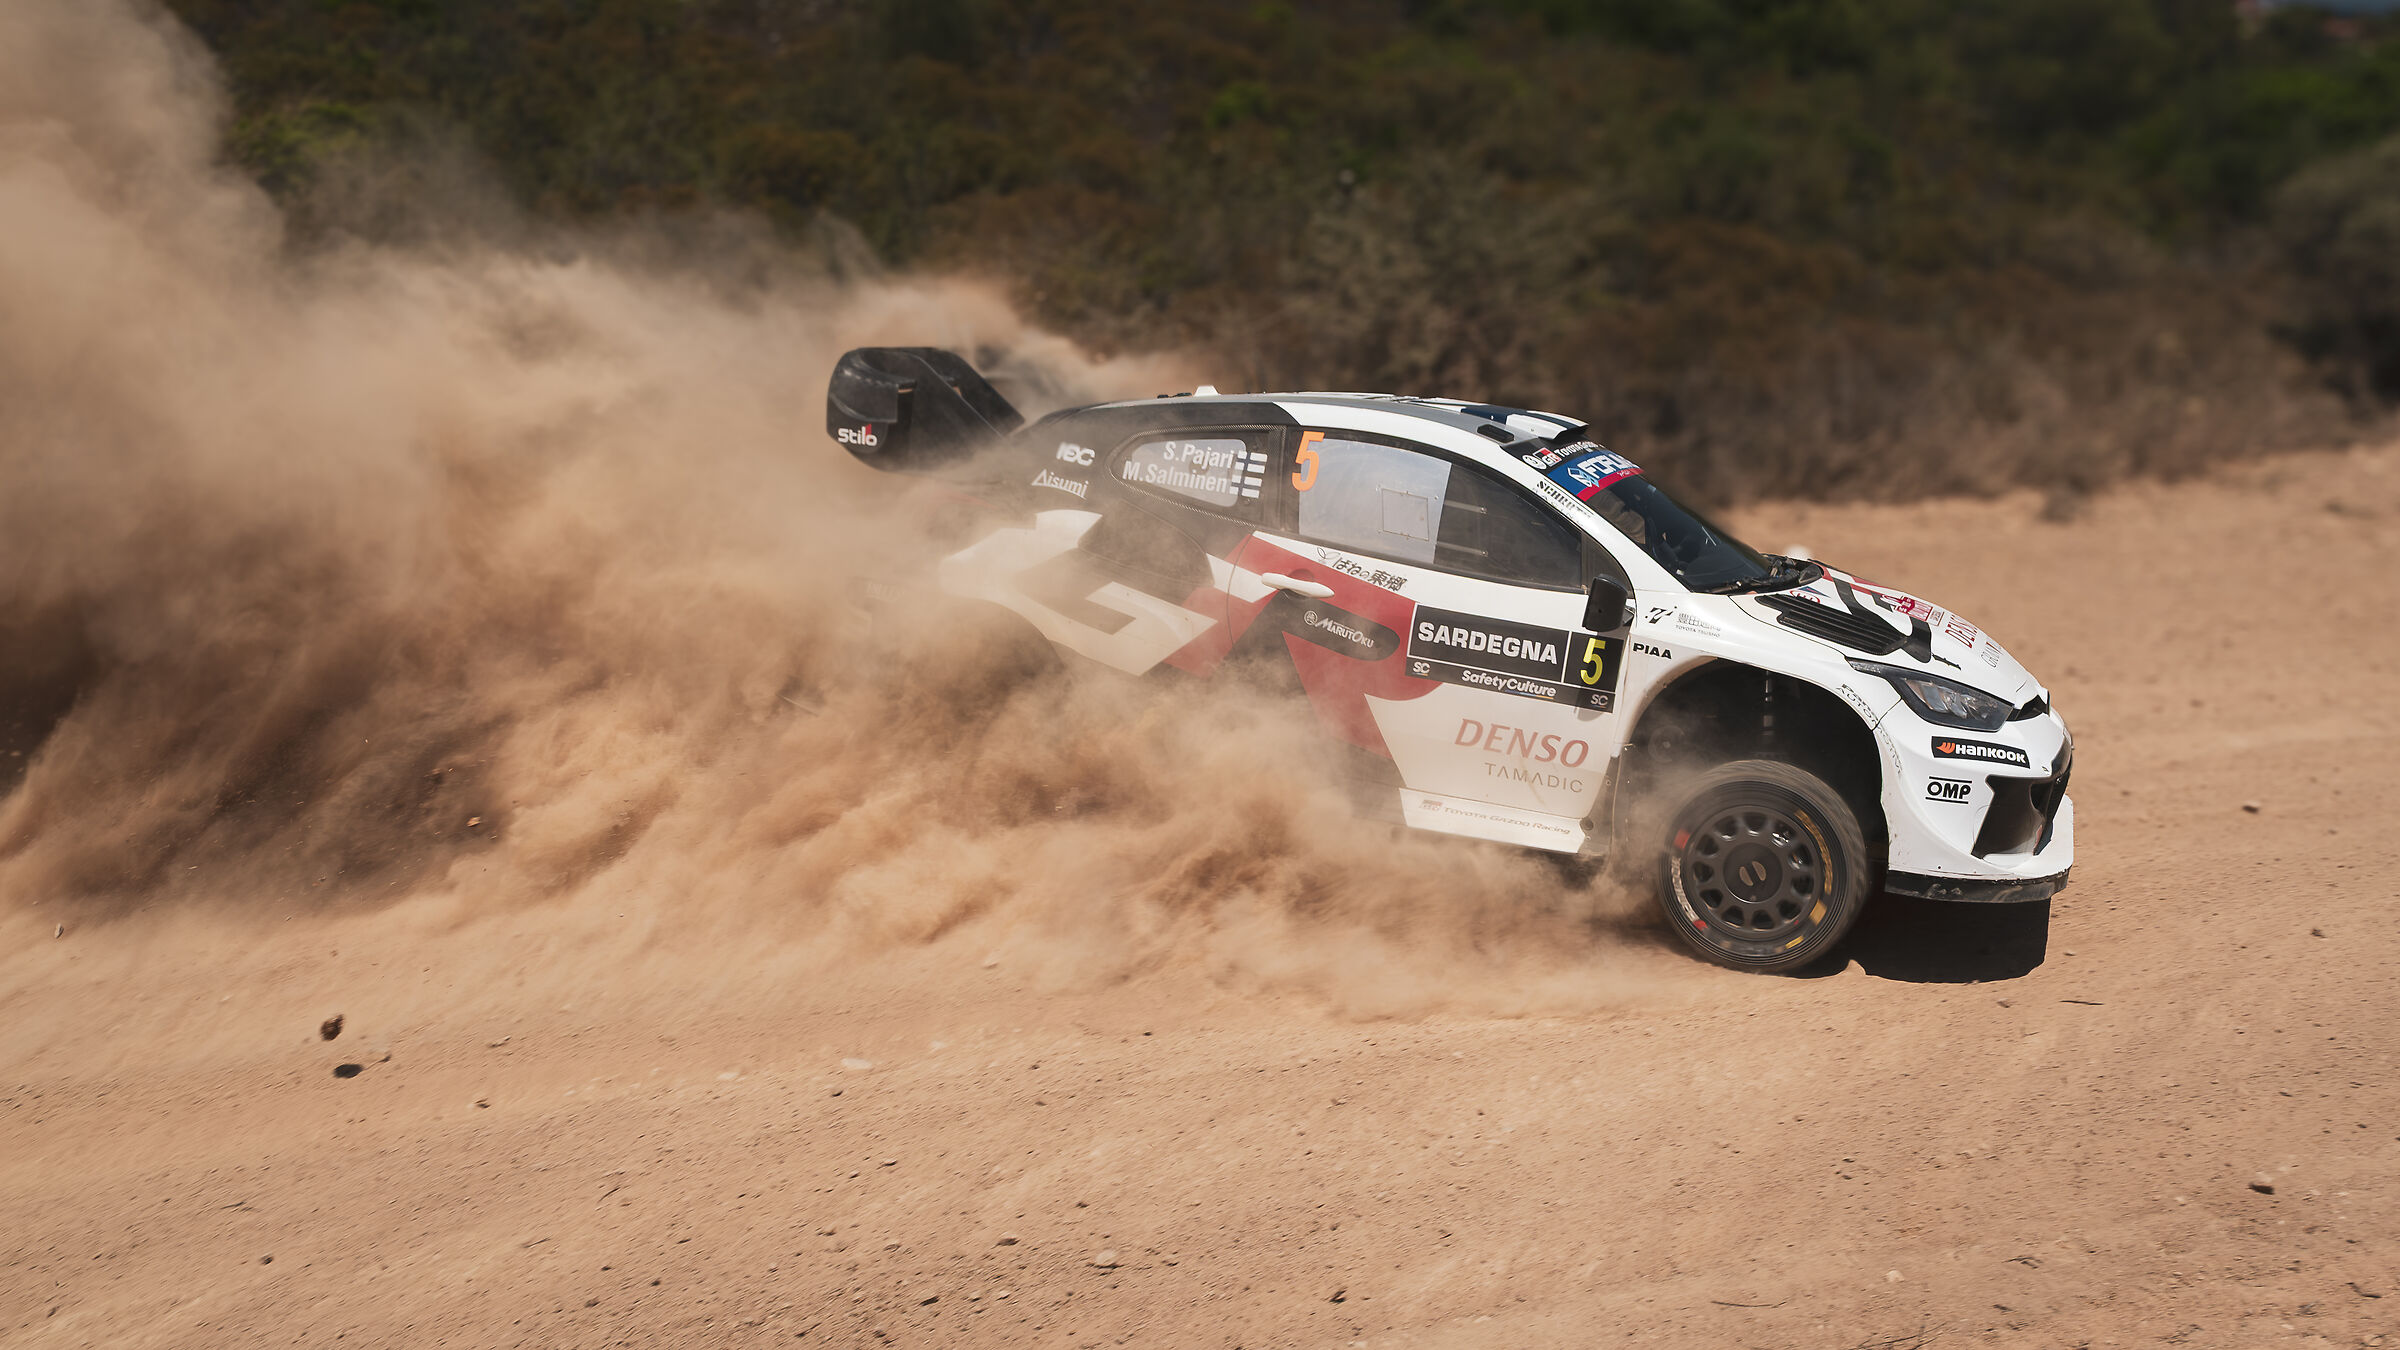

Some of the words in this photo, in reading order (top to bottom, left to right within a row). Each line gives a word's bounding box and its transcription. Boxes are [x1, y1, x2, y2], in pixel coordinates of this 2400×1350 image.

[1291, 430, 1325, 492] 5
[1031, 468, 1088, 500] Aisumi
[1418, 621, 1558, 665] SARDEGNA
[1580, 637, 1607, 685] 5
[1632, 642, 1672, 660] PIAA
[1412, 661, 1431, 675] SC
[1461, 669, 1557, 698] SafetyCulture
[1590, 693, 1609, 707] SC
[1454, 718, 1589, 768] DENSO
[1484, 762, 1584, 794] TAMADIC
[1927, 781, 1971, 799] OMP
[1532, 822, 1571, 835] Racing
